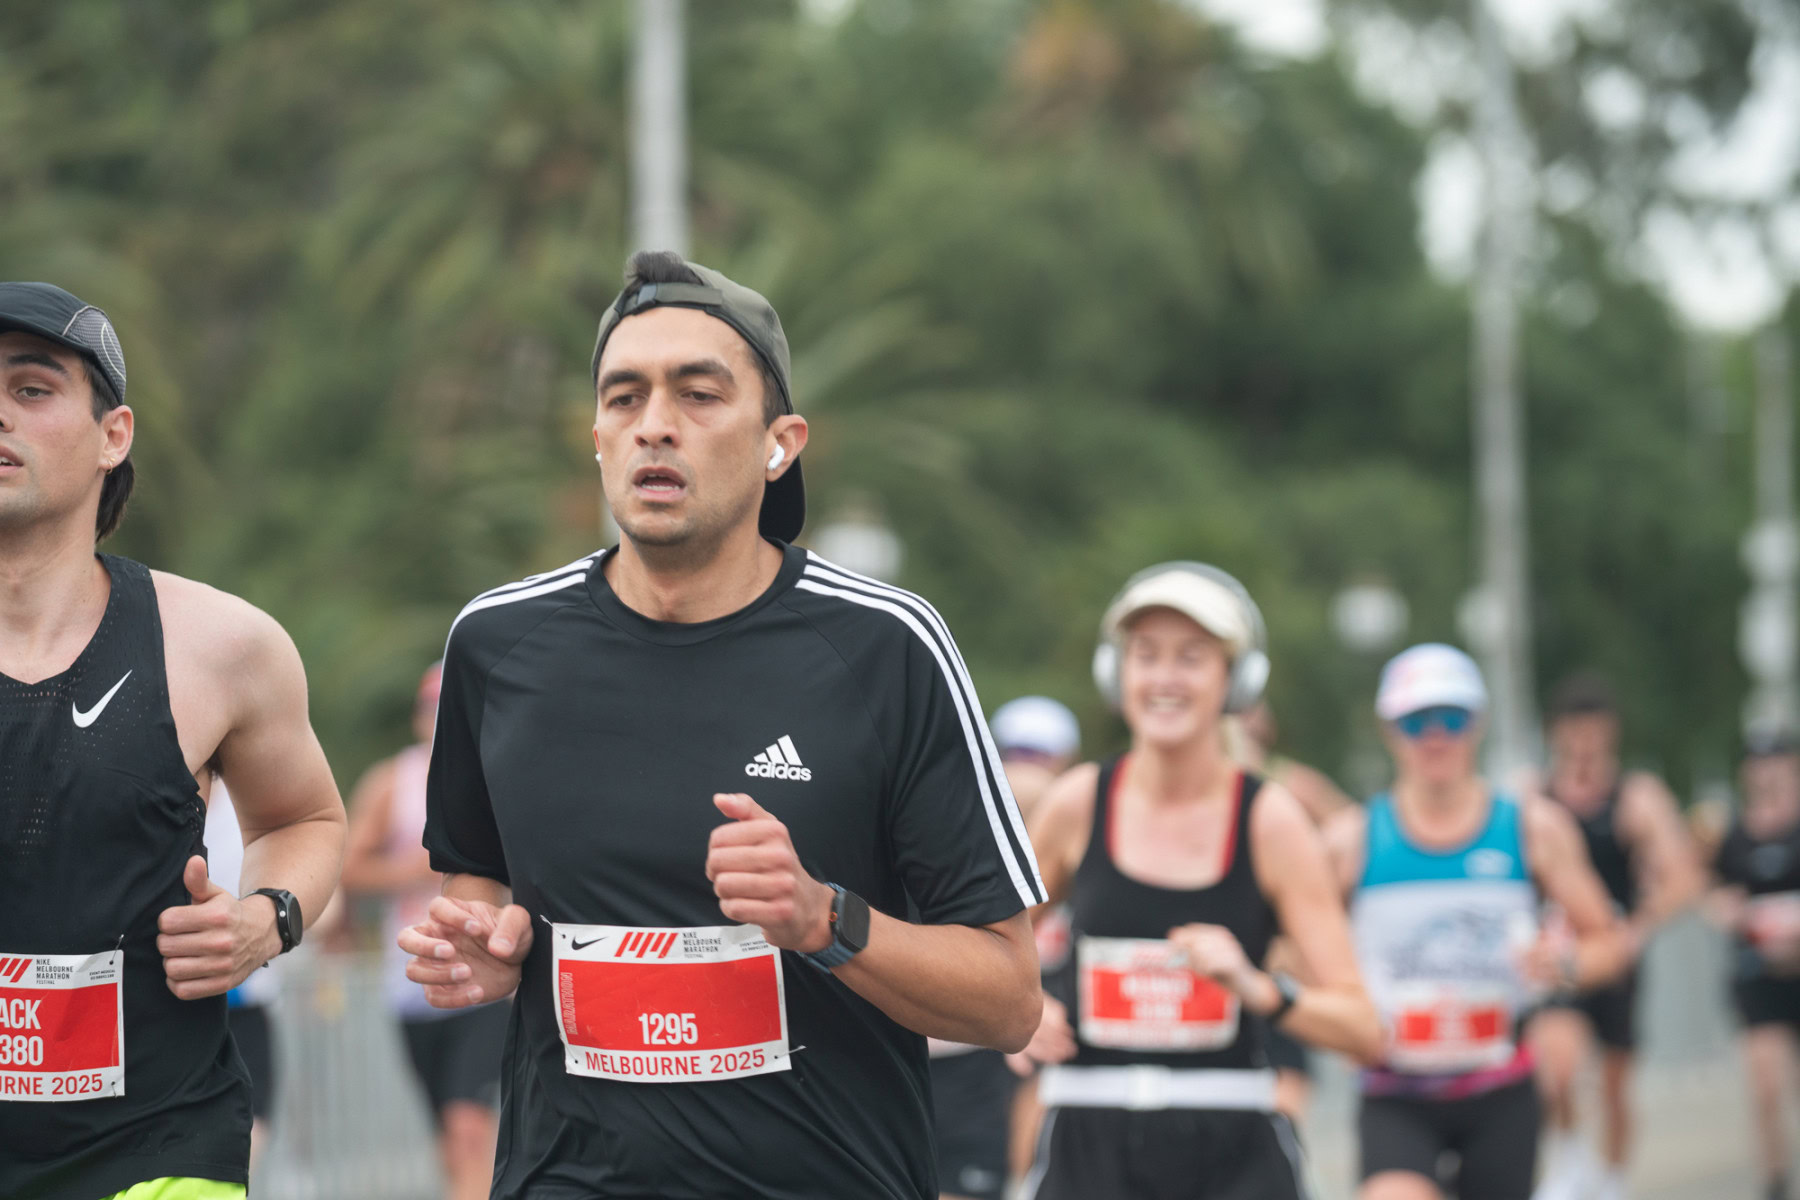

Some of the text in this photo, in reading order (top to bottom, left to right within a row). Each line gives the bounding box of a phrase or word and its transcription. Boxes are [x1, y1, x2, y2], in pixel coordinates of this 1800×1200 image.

[745, 761, 812, 781] adidas
[683, 938, 722, 946] MELBOURNE
[638, 1012, 699, 1045] 1295
[585, 1048, 765, 1076] MELBOURNE 2025
[0, 1073, 103, 1095] RNE 2025
